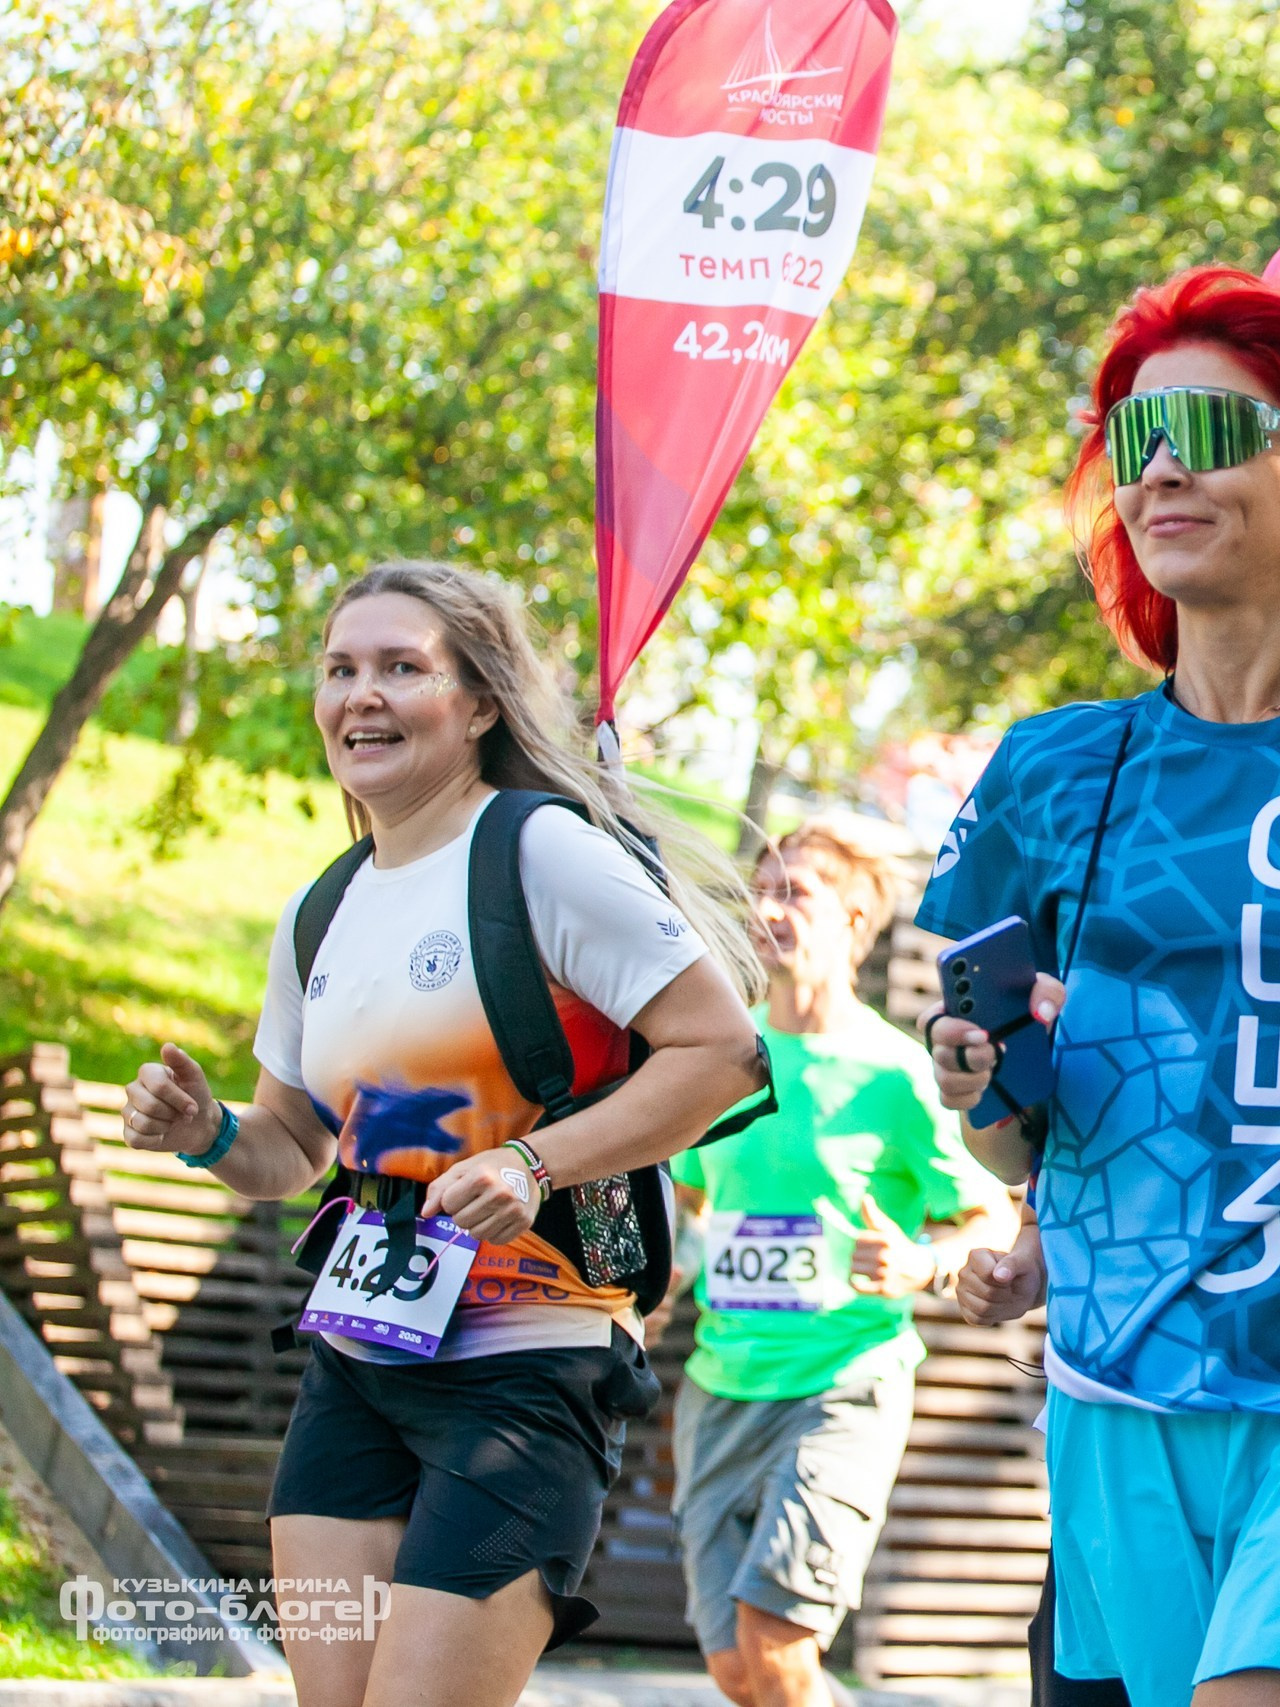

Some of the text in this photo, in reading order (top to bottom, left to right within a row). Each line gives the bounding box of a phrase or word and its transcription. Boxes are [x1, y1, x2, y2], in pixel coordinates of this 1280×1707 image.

[683, 155, 837, 238] 4:29
[679, 251, 823, 290] темп 622
[714, 1247, 817, 1281] 4023
